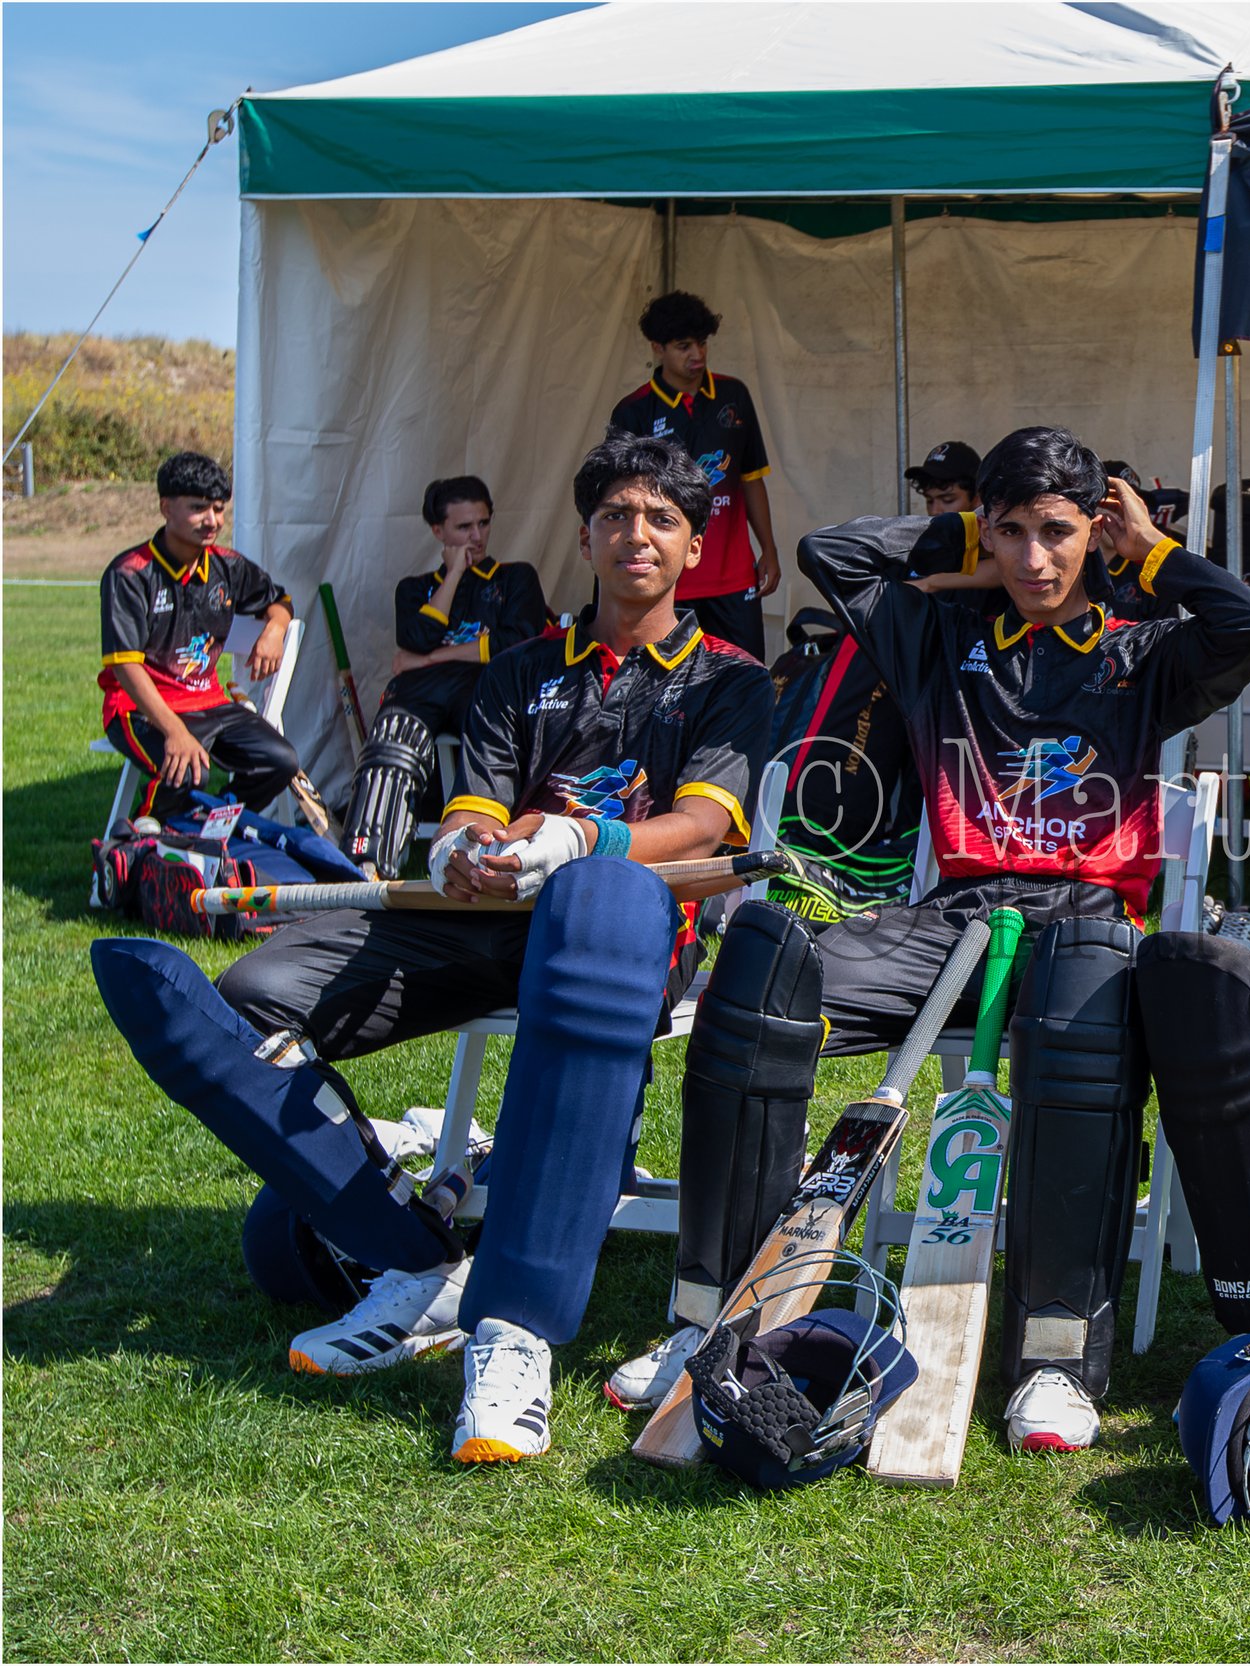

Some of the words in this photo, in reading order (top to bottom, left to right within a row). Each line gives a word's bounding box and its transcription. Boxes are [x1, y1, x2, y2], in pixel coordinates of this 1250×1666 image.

[851, 1153, 885, 1208] MARKHOR
[938, 1216, 970, 1228] BA
[921, 1227, 976, 1245] 56
